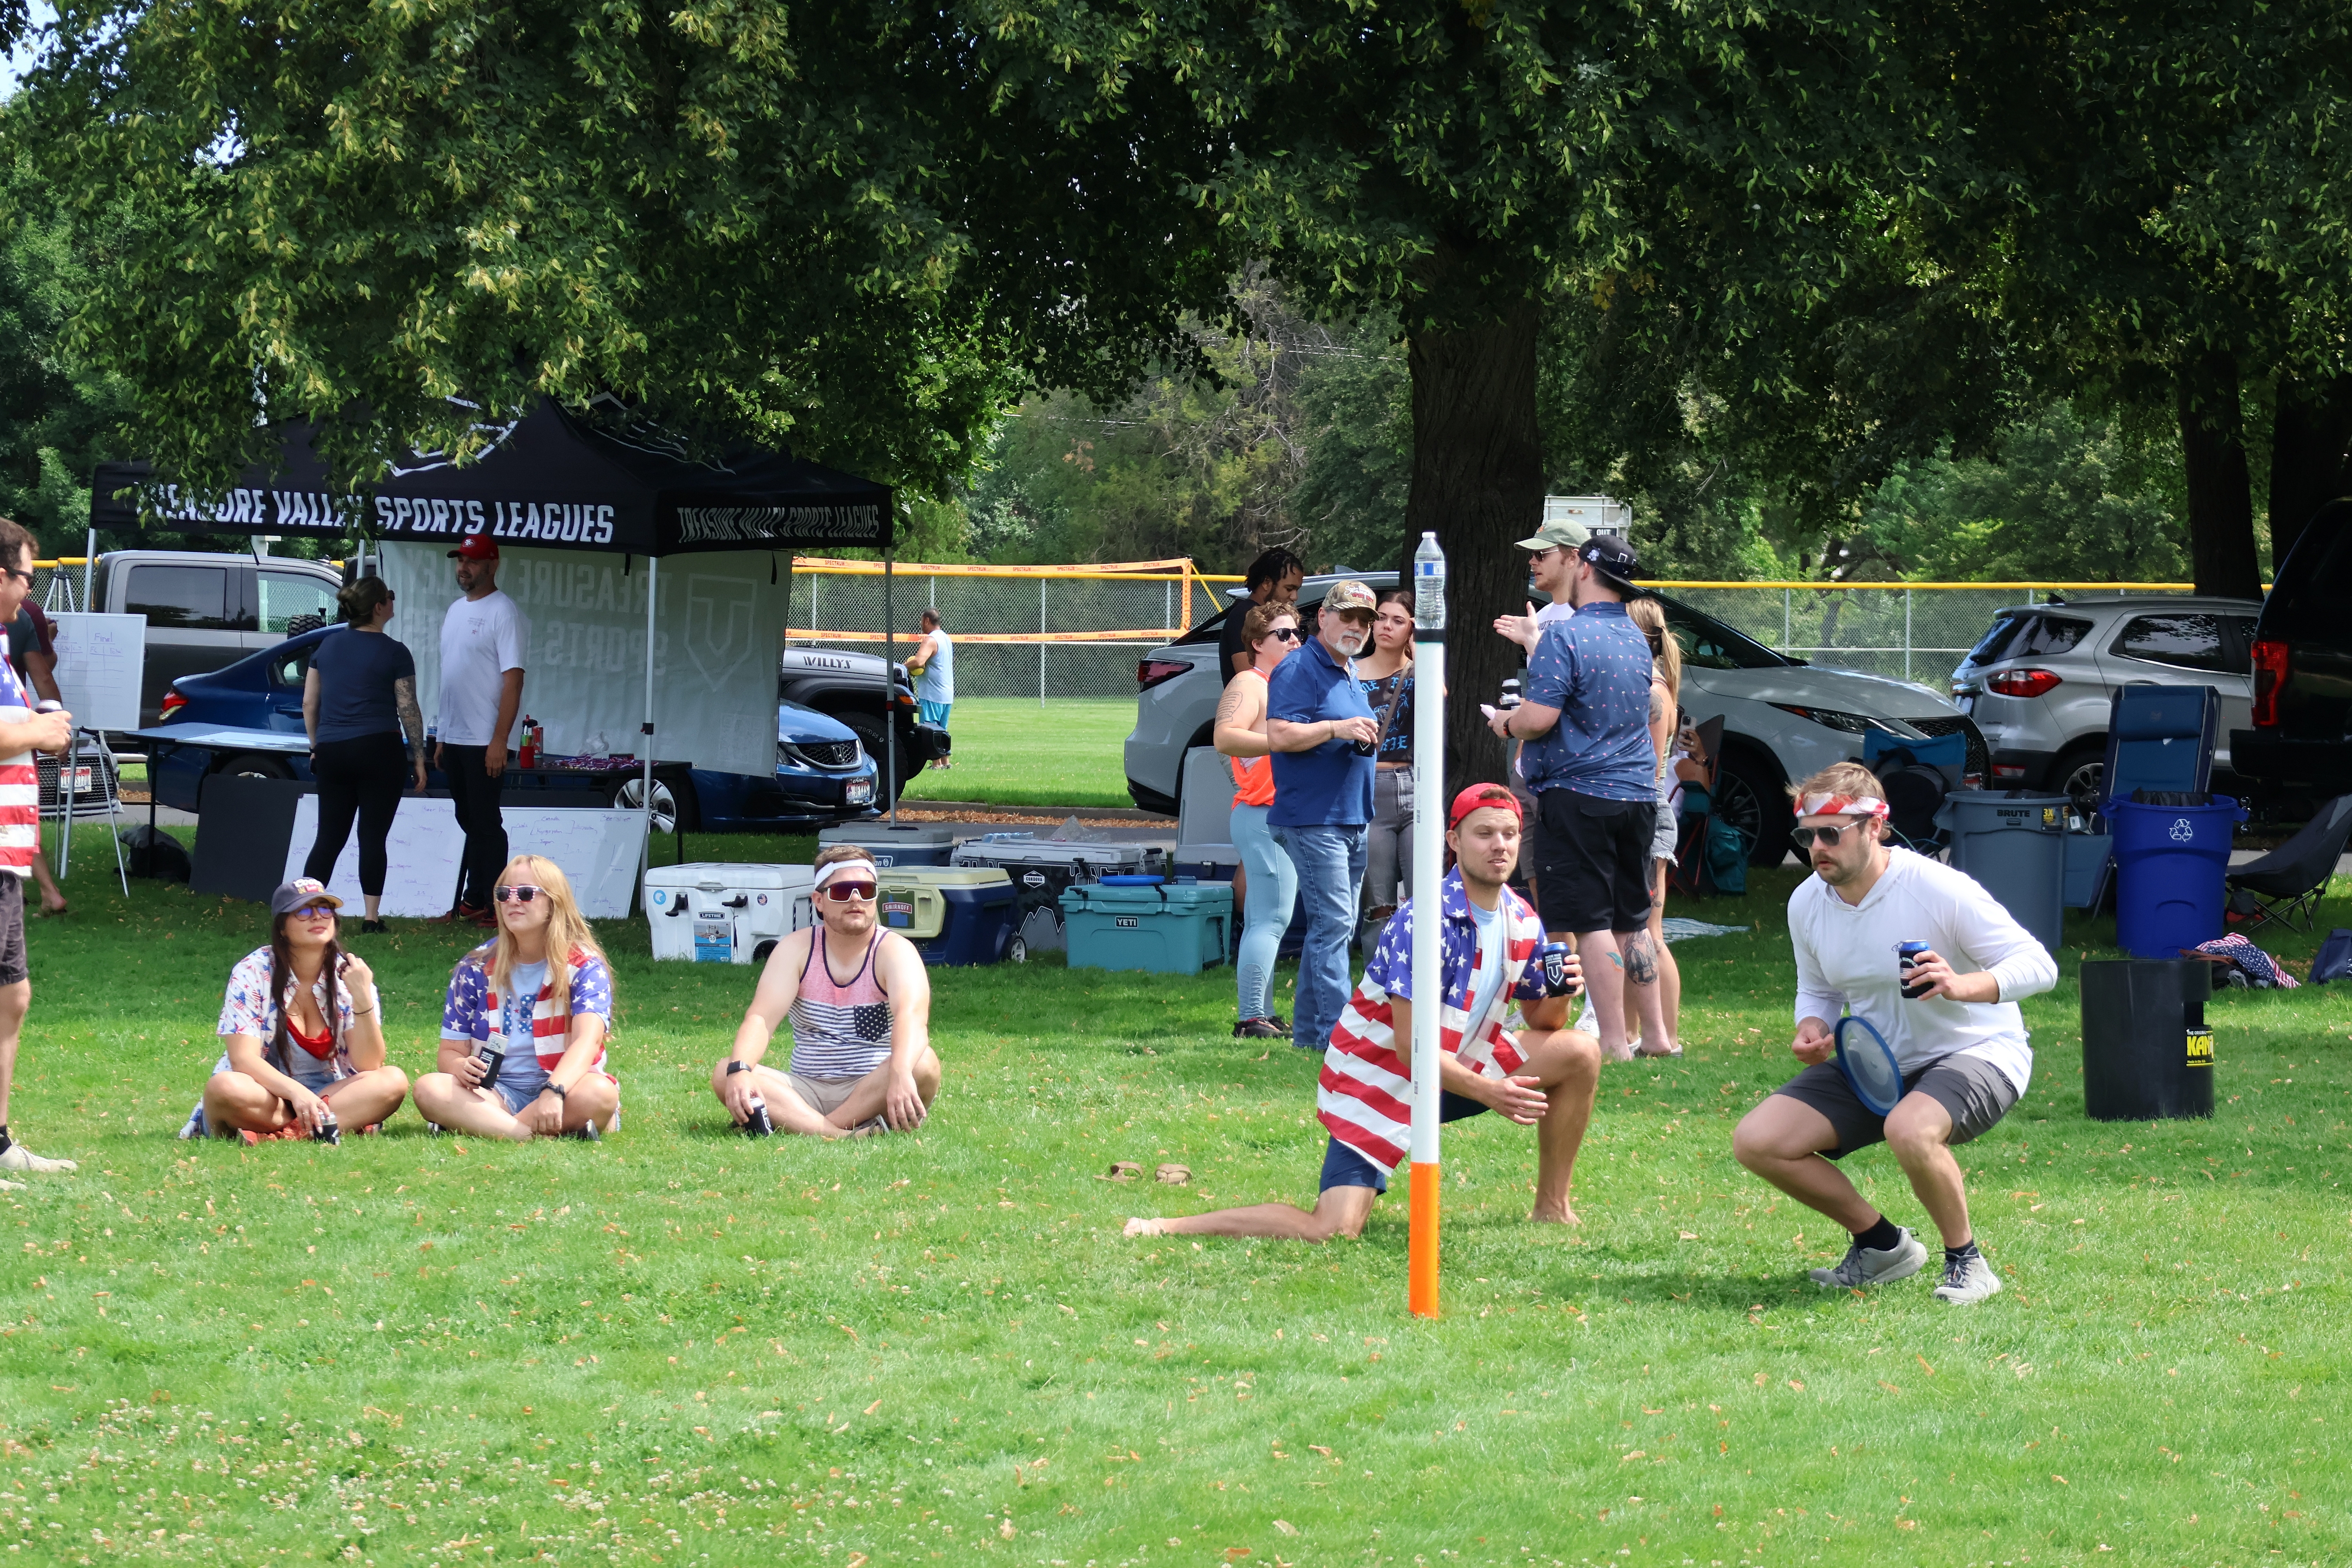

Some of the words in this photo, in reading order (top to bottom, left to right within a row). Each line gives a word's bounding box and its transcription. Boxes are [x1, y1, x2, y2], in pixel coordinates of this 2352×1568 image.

[375, 496, 485, 534] SPORTS
[493, 501, 614, 543] LEAGUES
[677, 507, 742, 543] TREASURE
[779, 506, 832, 538] SPORTS
[828, 505, 879, 538] LEAGUES
[803, 656, 851, 669] WILLYS
[2043, 808, 2053, 817] 3X
